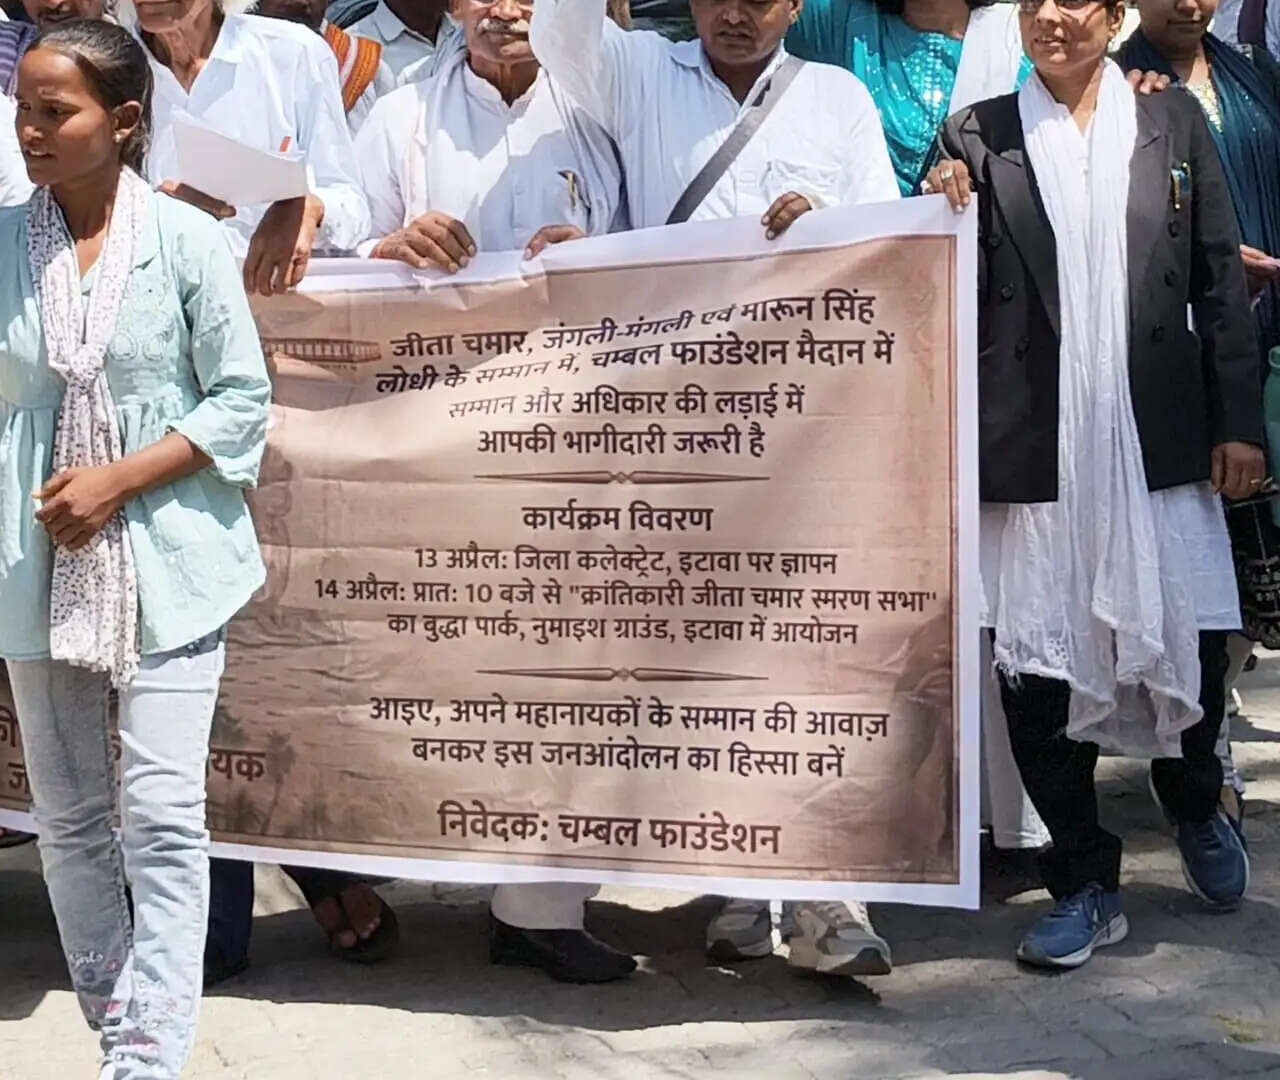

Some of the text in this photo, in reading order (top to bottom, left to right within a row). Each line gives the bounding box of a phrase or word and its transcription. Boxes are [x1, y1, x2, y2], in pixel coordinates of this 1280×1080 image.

[390, 333, 455, 357] जीता
[462, 330, 533, 356] चमार,
[700, 303, 737, 324] एवं
[741, 295, 816, 322] मारून
[822, 287, 876, 324] सिंह
[375, 329, 895, 393] लोधी के सम्मान में, चम्बल फाउंडेशन मैदान में
[448, 383, 805, 420] सम्मान और अधिकार की लड़ाई में
[477, 421, 766, 458] आपकी भागीदारी जरूरी है
[521, 498, 714, 532] कार्यक्रम विवरण
[414, 548, 438, 568] 13
[445, 540, 507, 570] अप्रैल:
[514, 544, 569, 570] जिला
[678, 551, 739, 575] इटावा
[746, 552, 774, 573] पर
[780, 553, 838, 576] ज्ञापन
[315, 579, 339, 599] 14
[345, 572, 406, 601] अप्रैल:
[412, 581, 458, 603] प्रात:
[467, 583, 492, 603] 10
[542, 578, 562, 604] से
[692, 579, 744, 607] जीता
[751, 588, 804, 609] चमार
[811, 589, 870, 610] स्मरण
[877, 591, 937, 612] सभा"
[387, 613, 416, 634] का
[474, 610, 525, 641] पार्क,
[532, 617, 606, 645] नुमाइश
[613, 613, 675, 643] ग्राउंड,
[682, 619, 743, 643] इटावा
[750, 615, 767, 640] में
[772, 615, 857, 644] आयोजन
[370, 693, 890, 741] आइए, अपने महानायकों के सम्मान की आवाज़
[411, 736, 846, 777] बनकर इस जनआंदोलन का हिस्सा बनें
[437, 799, 782, 854] निवेदक: चम्बल फाउंडेशन
